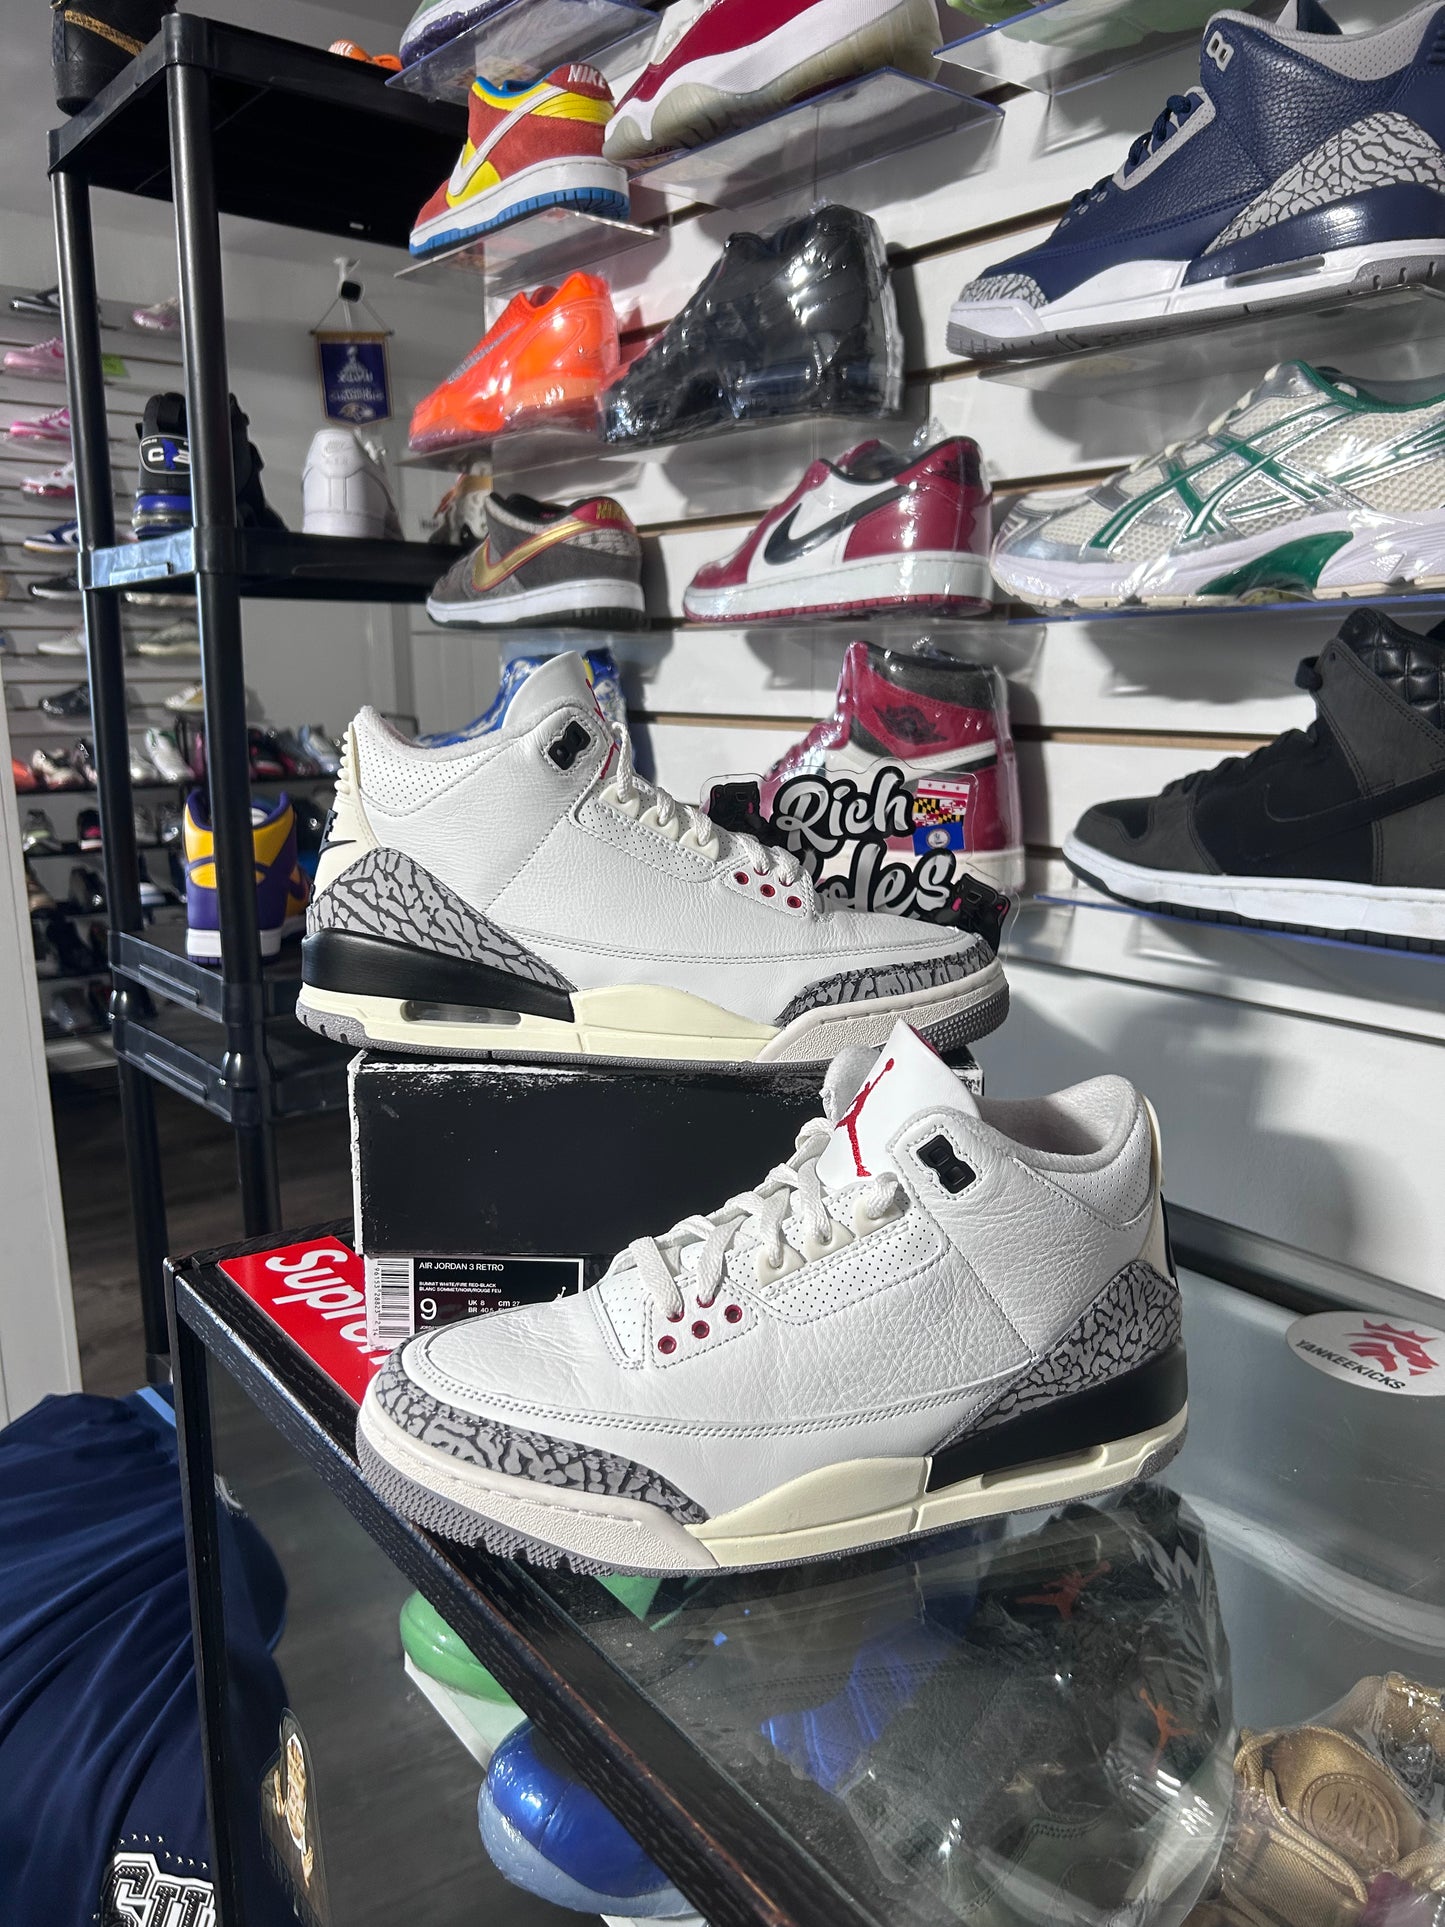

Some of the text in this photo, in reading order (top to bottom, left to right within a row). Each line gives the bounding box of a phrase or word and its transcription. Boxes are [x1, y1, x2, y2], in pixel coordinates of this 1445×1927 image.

[567, 64, 606, 89] NIKE
[776, 766, 911, 852] Rich
[418, 1262, 505, 1271] AIR JORDAN 3 RETRO
[420, 1298, 437, 1320] 9
[1296, 1339, 1406, 1389] YANKEEKICKS
